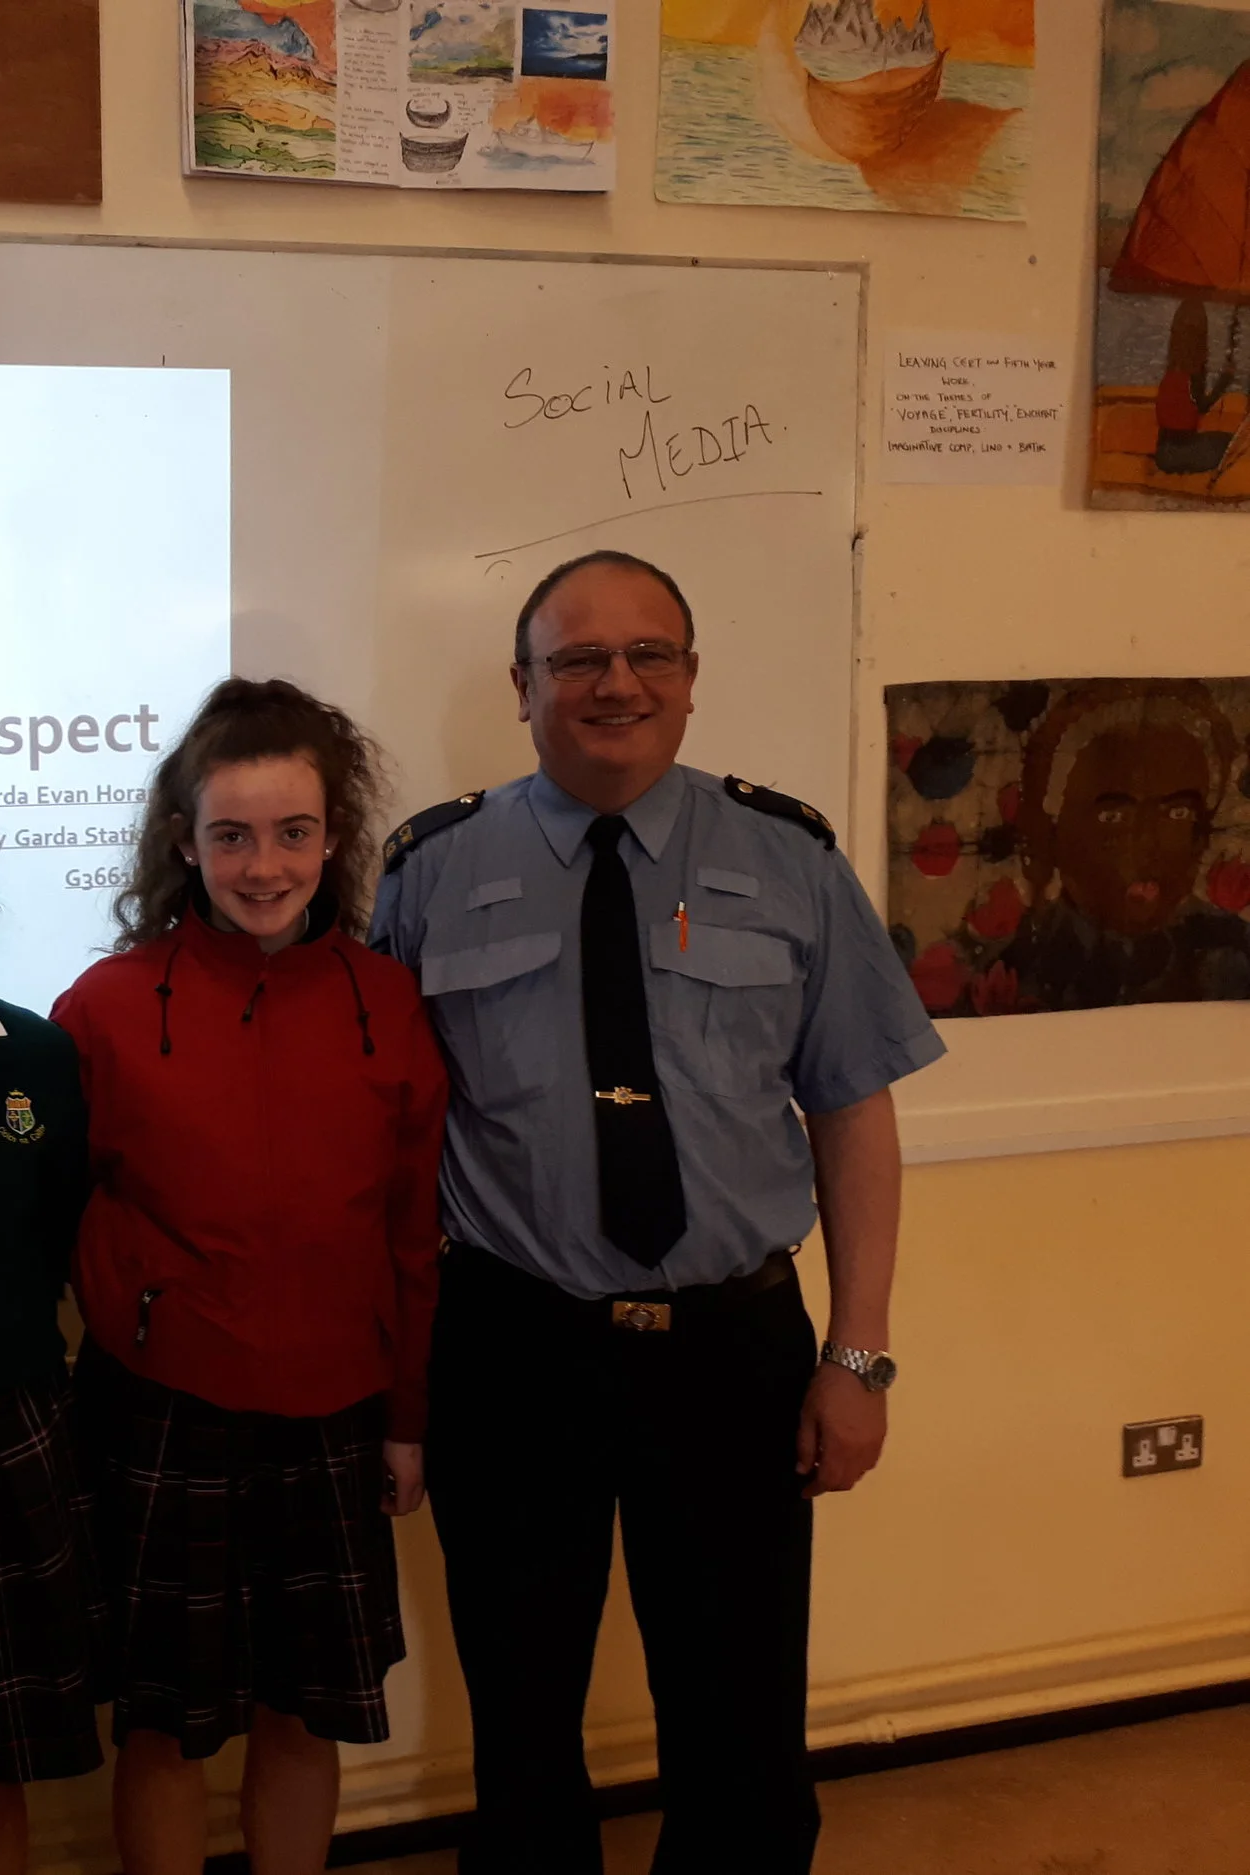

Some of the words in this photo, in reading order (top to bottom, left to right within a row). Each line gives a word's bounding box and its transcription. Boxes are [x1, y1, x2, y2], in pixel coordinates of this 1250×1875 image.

[899, 352, 947, 371] LEAVING
[37, 786, 88, 804] Evan
[97, 784, 150, 802] Hora
[15, 826, 78, 846] Garda
[85, 823, 141, 845] Stati
